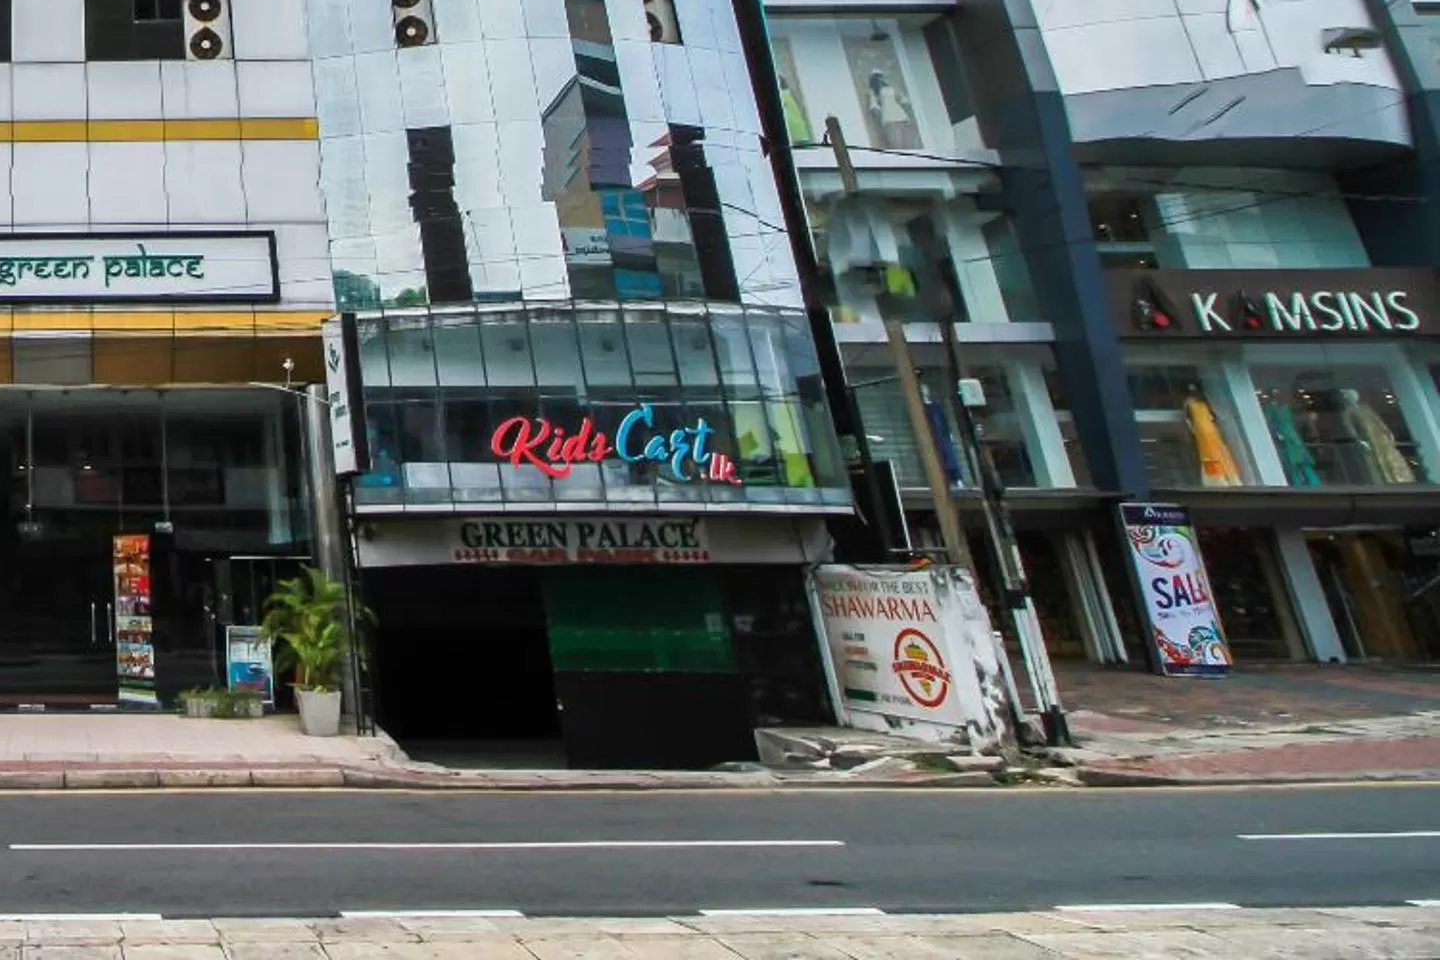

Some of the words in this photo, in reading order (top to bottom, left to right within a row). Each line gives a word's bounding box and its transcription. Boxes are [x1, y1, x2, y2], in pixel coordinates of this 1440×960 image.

[103, 243, 204, 287] palace
[491, 415, 613, 479] Kids
[461, 522, 567, 548] GREEN
[575, 520, 700, 548] PALACE
[880, 581, 900, 593] THE
[902, 581, 929, 594] BEST
[822, 596, 937, 622] SHAWARMA
